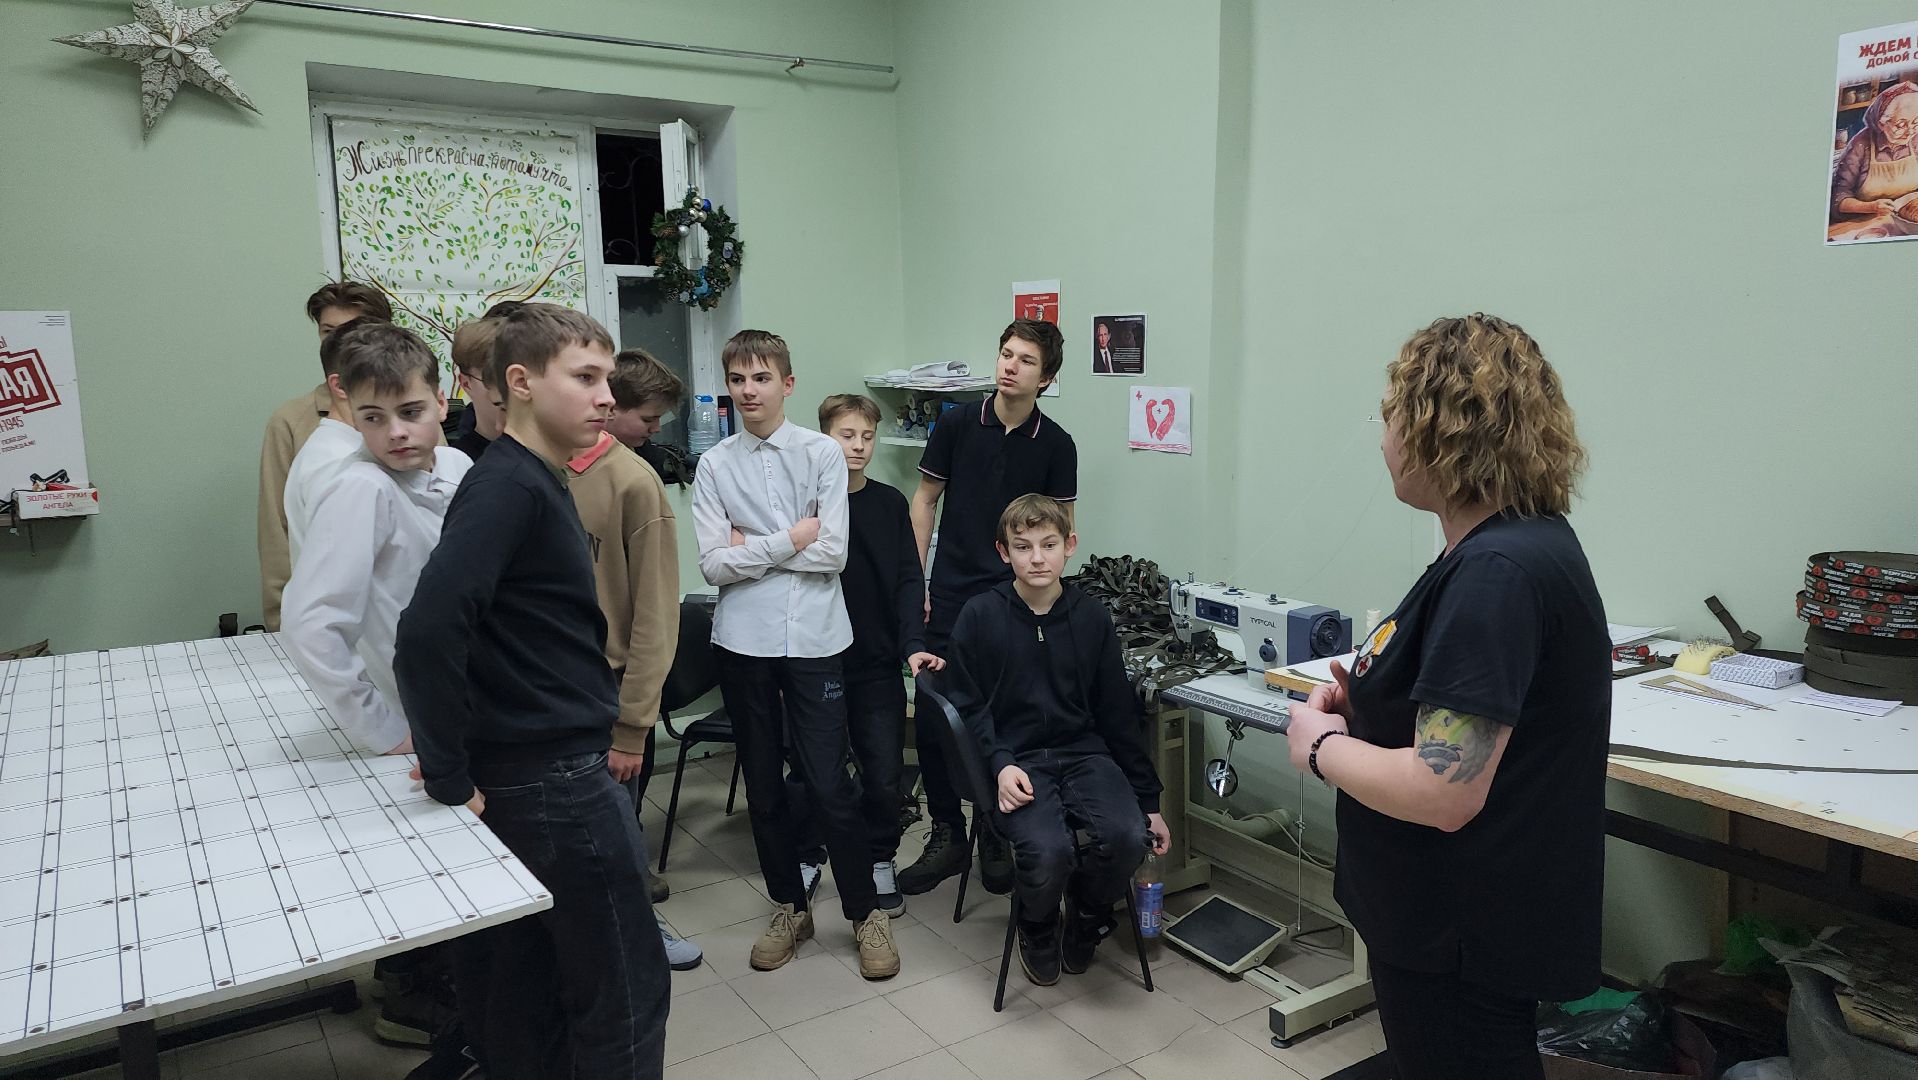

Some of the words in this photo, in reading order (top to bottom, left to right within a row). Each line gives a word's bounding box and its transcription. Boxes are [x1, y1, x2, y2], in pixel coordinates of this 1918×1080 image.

[1859, 37, 1911, 58] ЖДЕМ
[1866, 51, 1910, 69] ДОМОЙ
[340, 140, 408, 182] Жизнь
[0, 366, 40, 401] АЯ
[26, 493, 65, 502] ЗОЛОТЫЕ
[42, 501, 74, 510] АНГЕЛА
